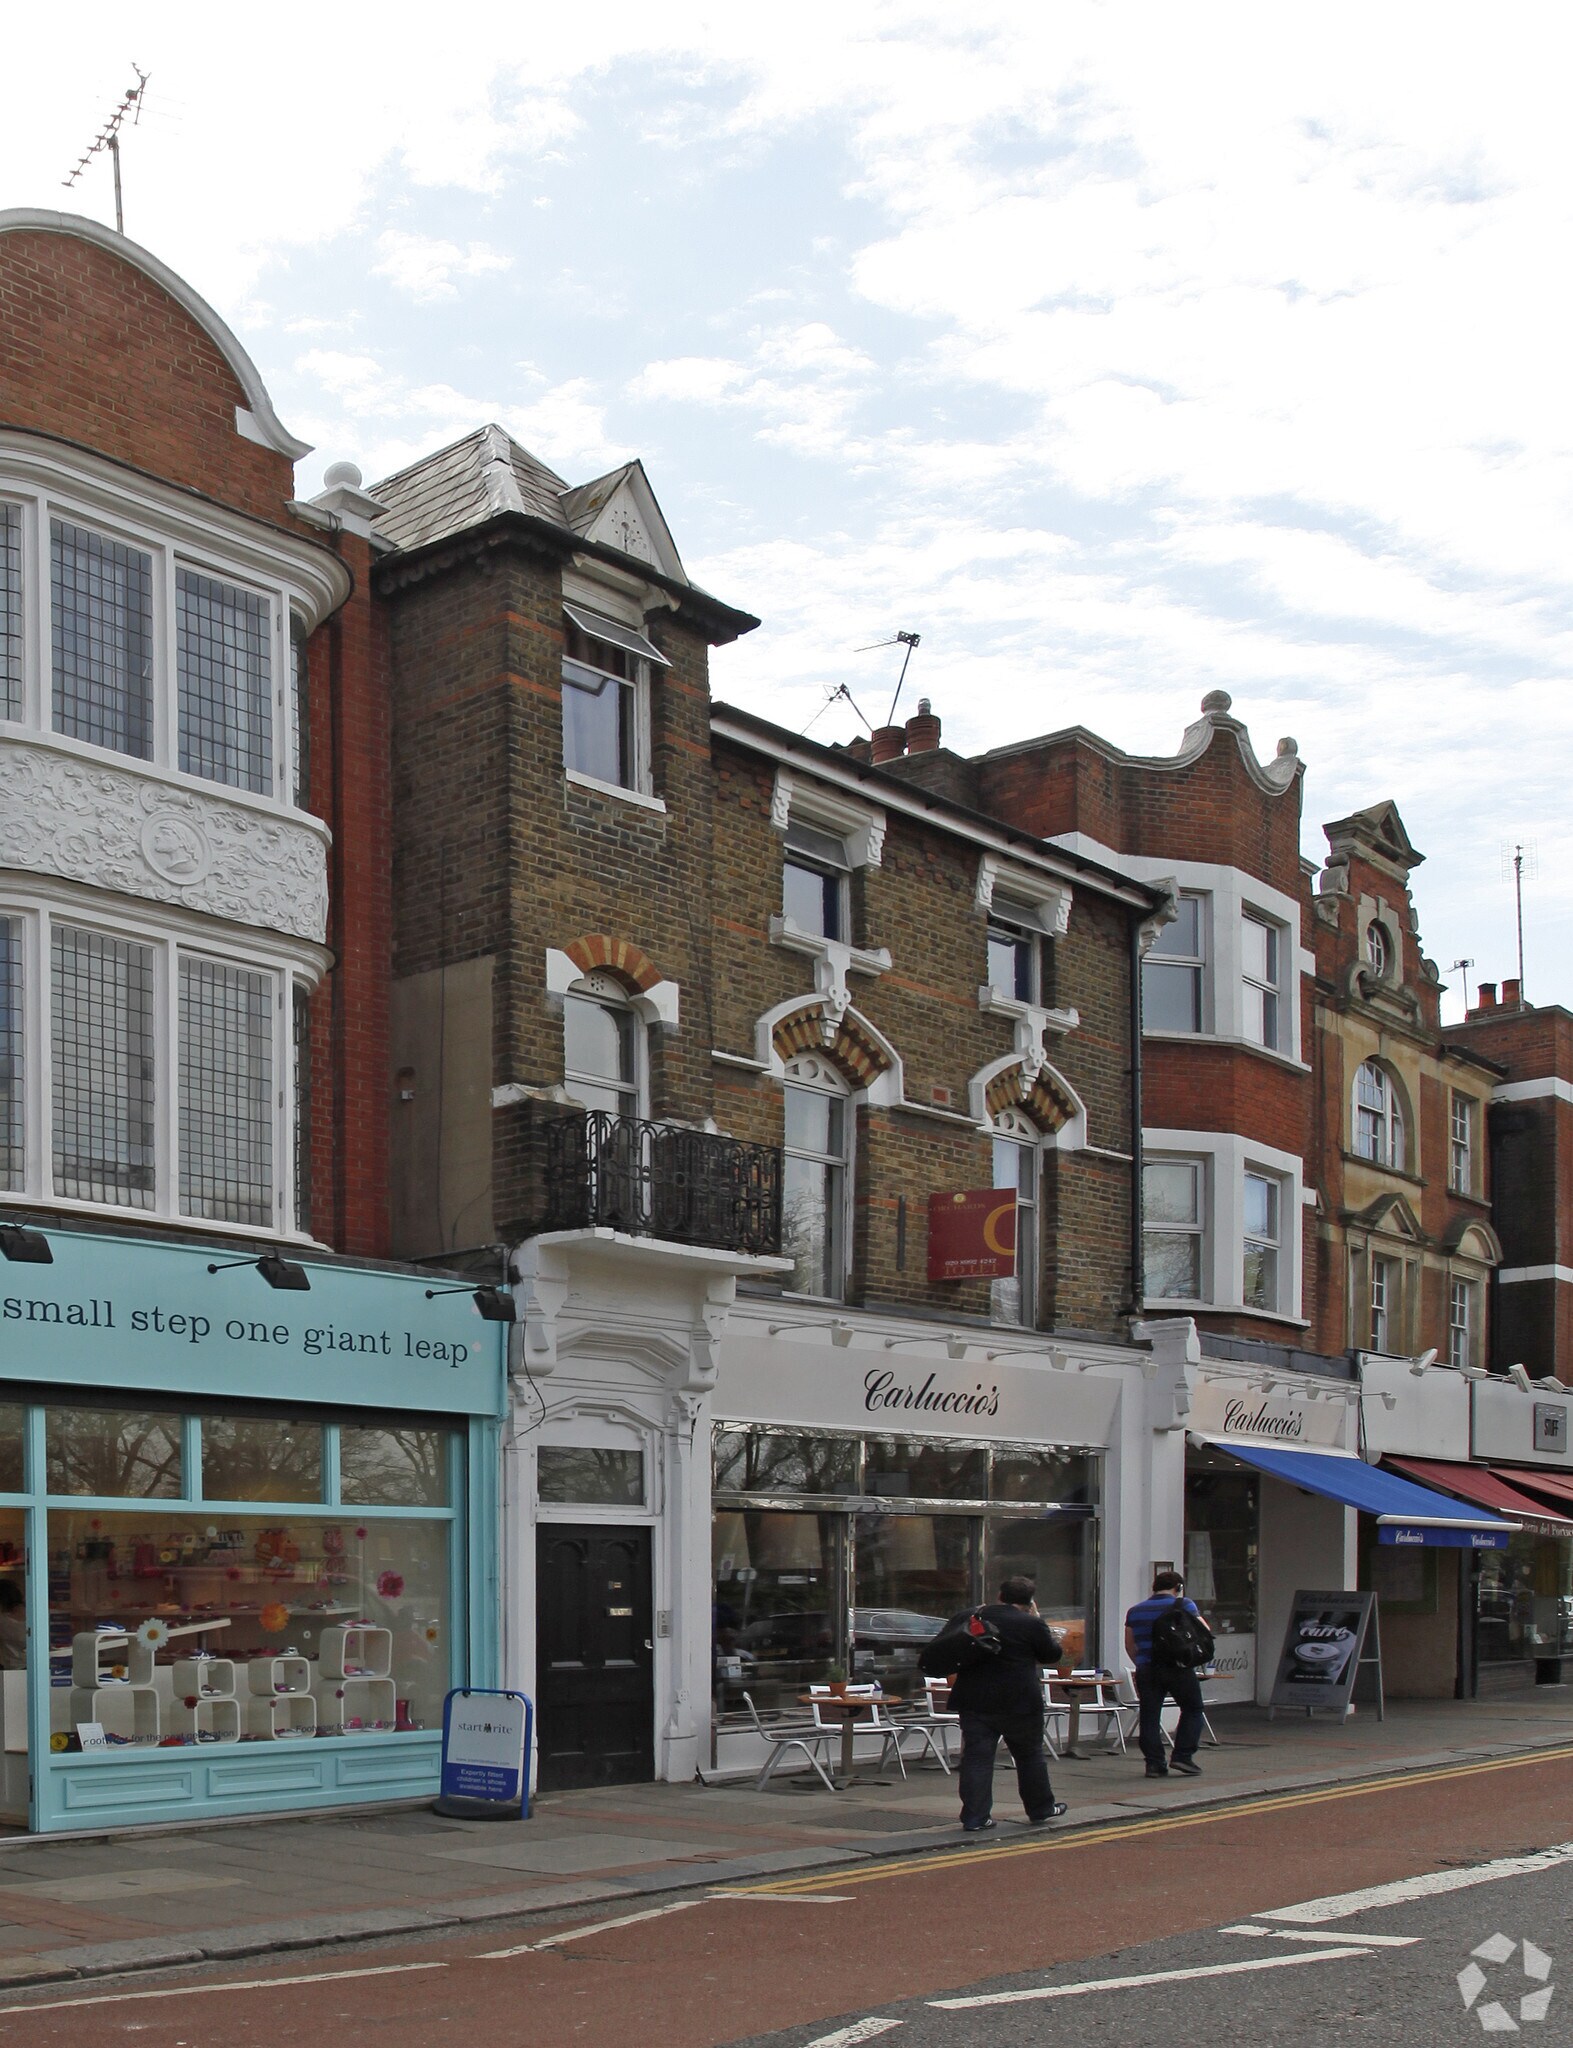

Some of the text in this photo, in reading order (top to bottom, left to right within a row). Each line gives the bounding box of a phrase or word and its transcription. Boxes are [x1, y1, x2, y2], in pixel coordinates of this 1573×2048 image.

[3, 1298, 469, 1368] small step one giant leap
[864, 1369, 1000, 1416] Carluccio's
[1223, 1398, 1303, 1436] Carluccio's
[147, 1733, 161, 1742] the
